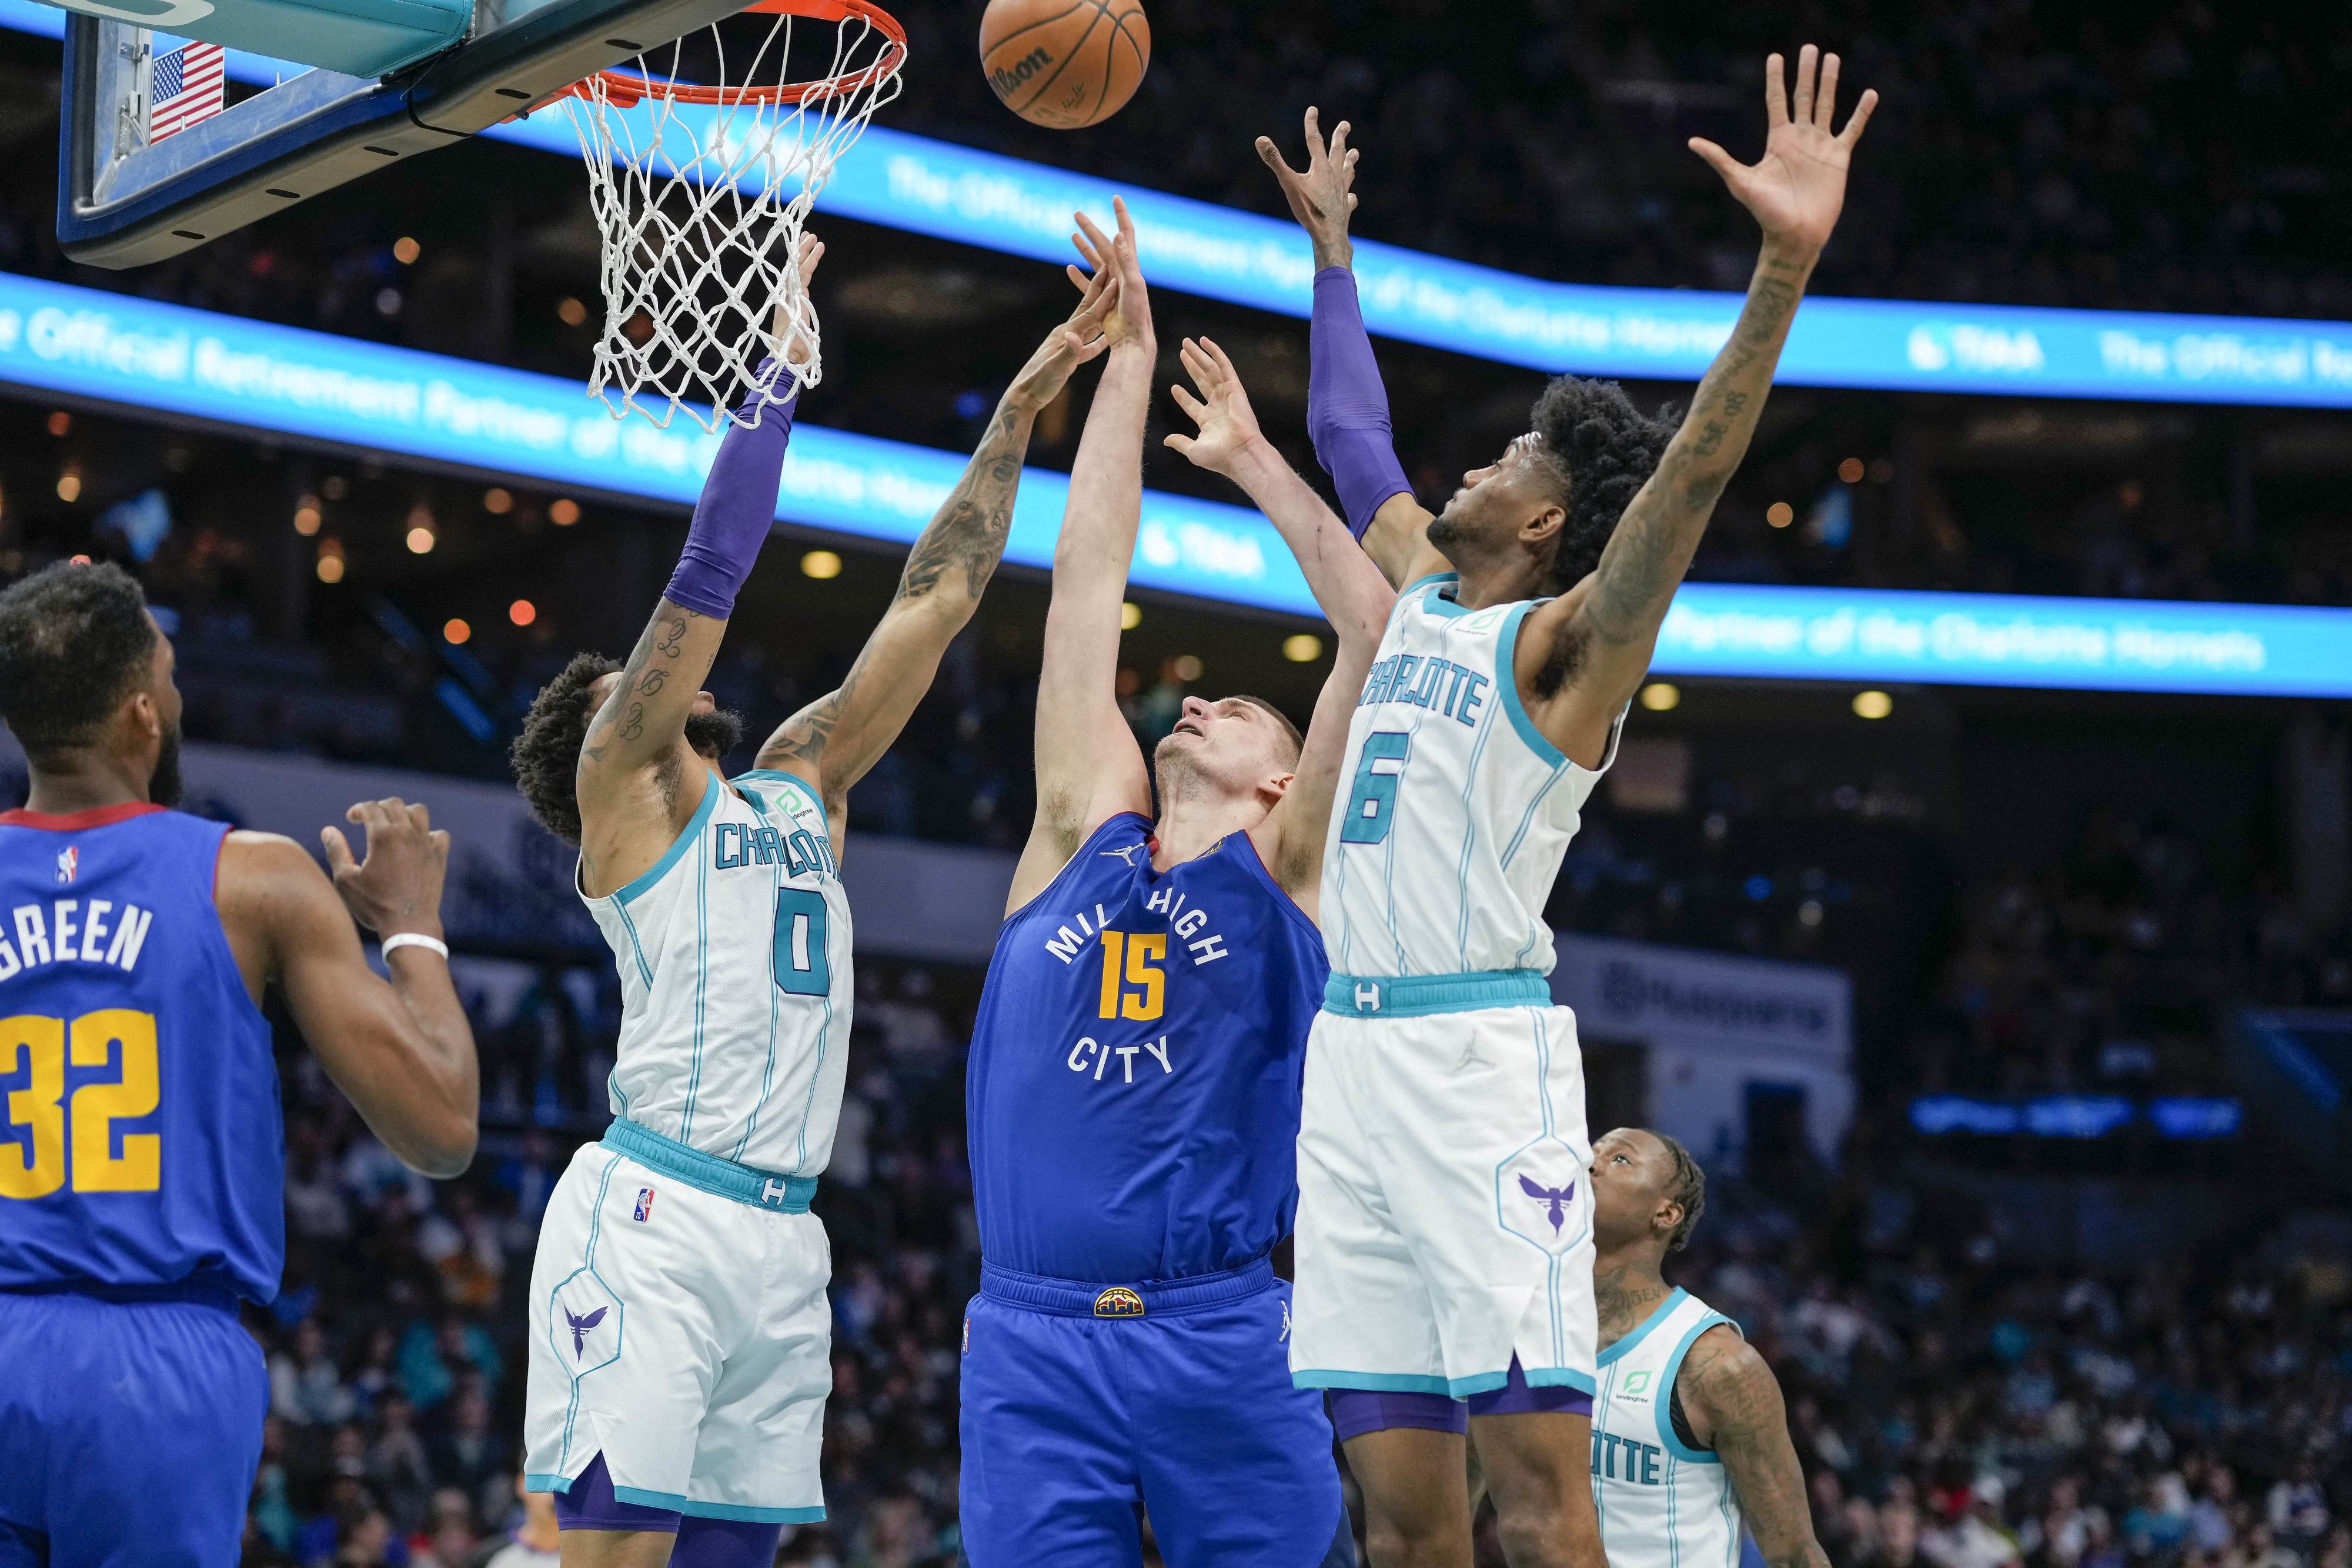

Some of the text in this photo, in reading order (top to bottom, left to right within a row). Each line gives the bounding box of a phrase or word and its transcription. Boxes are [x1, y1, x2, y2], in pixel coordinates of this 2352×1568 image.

[27, 306, 191, 383] Official
[194, 336, 420, 427] Retirement
[1929, 613, 2106, 666] Charlotte
[1340, 732, 1409, 844] 6
[773, 887, 830, 997] 0
[1045, 887, 1228, 965] MIL HIGH
[1099, 930, 1167, 1021] 15
[0, 1008, 161, 1199] 32
[1068, 1035, 1172, 1083] CITY
